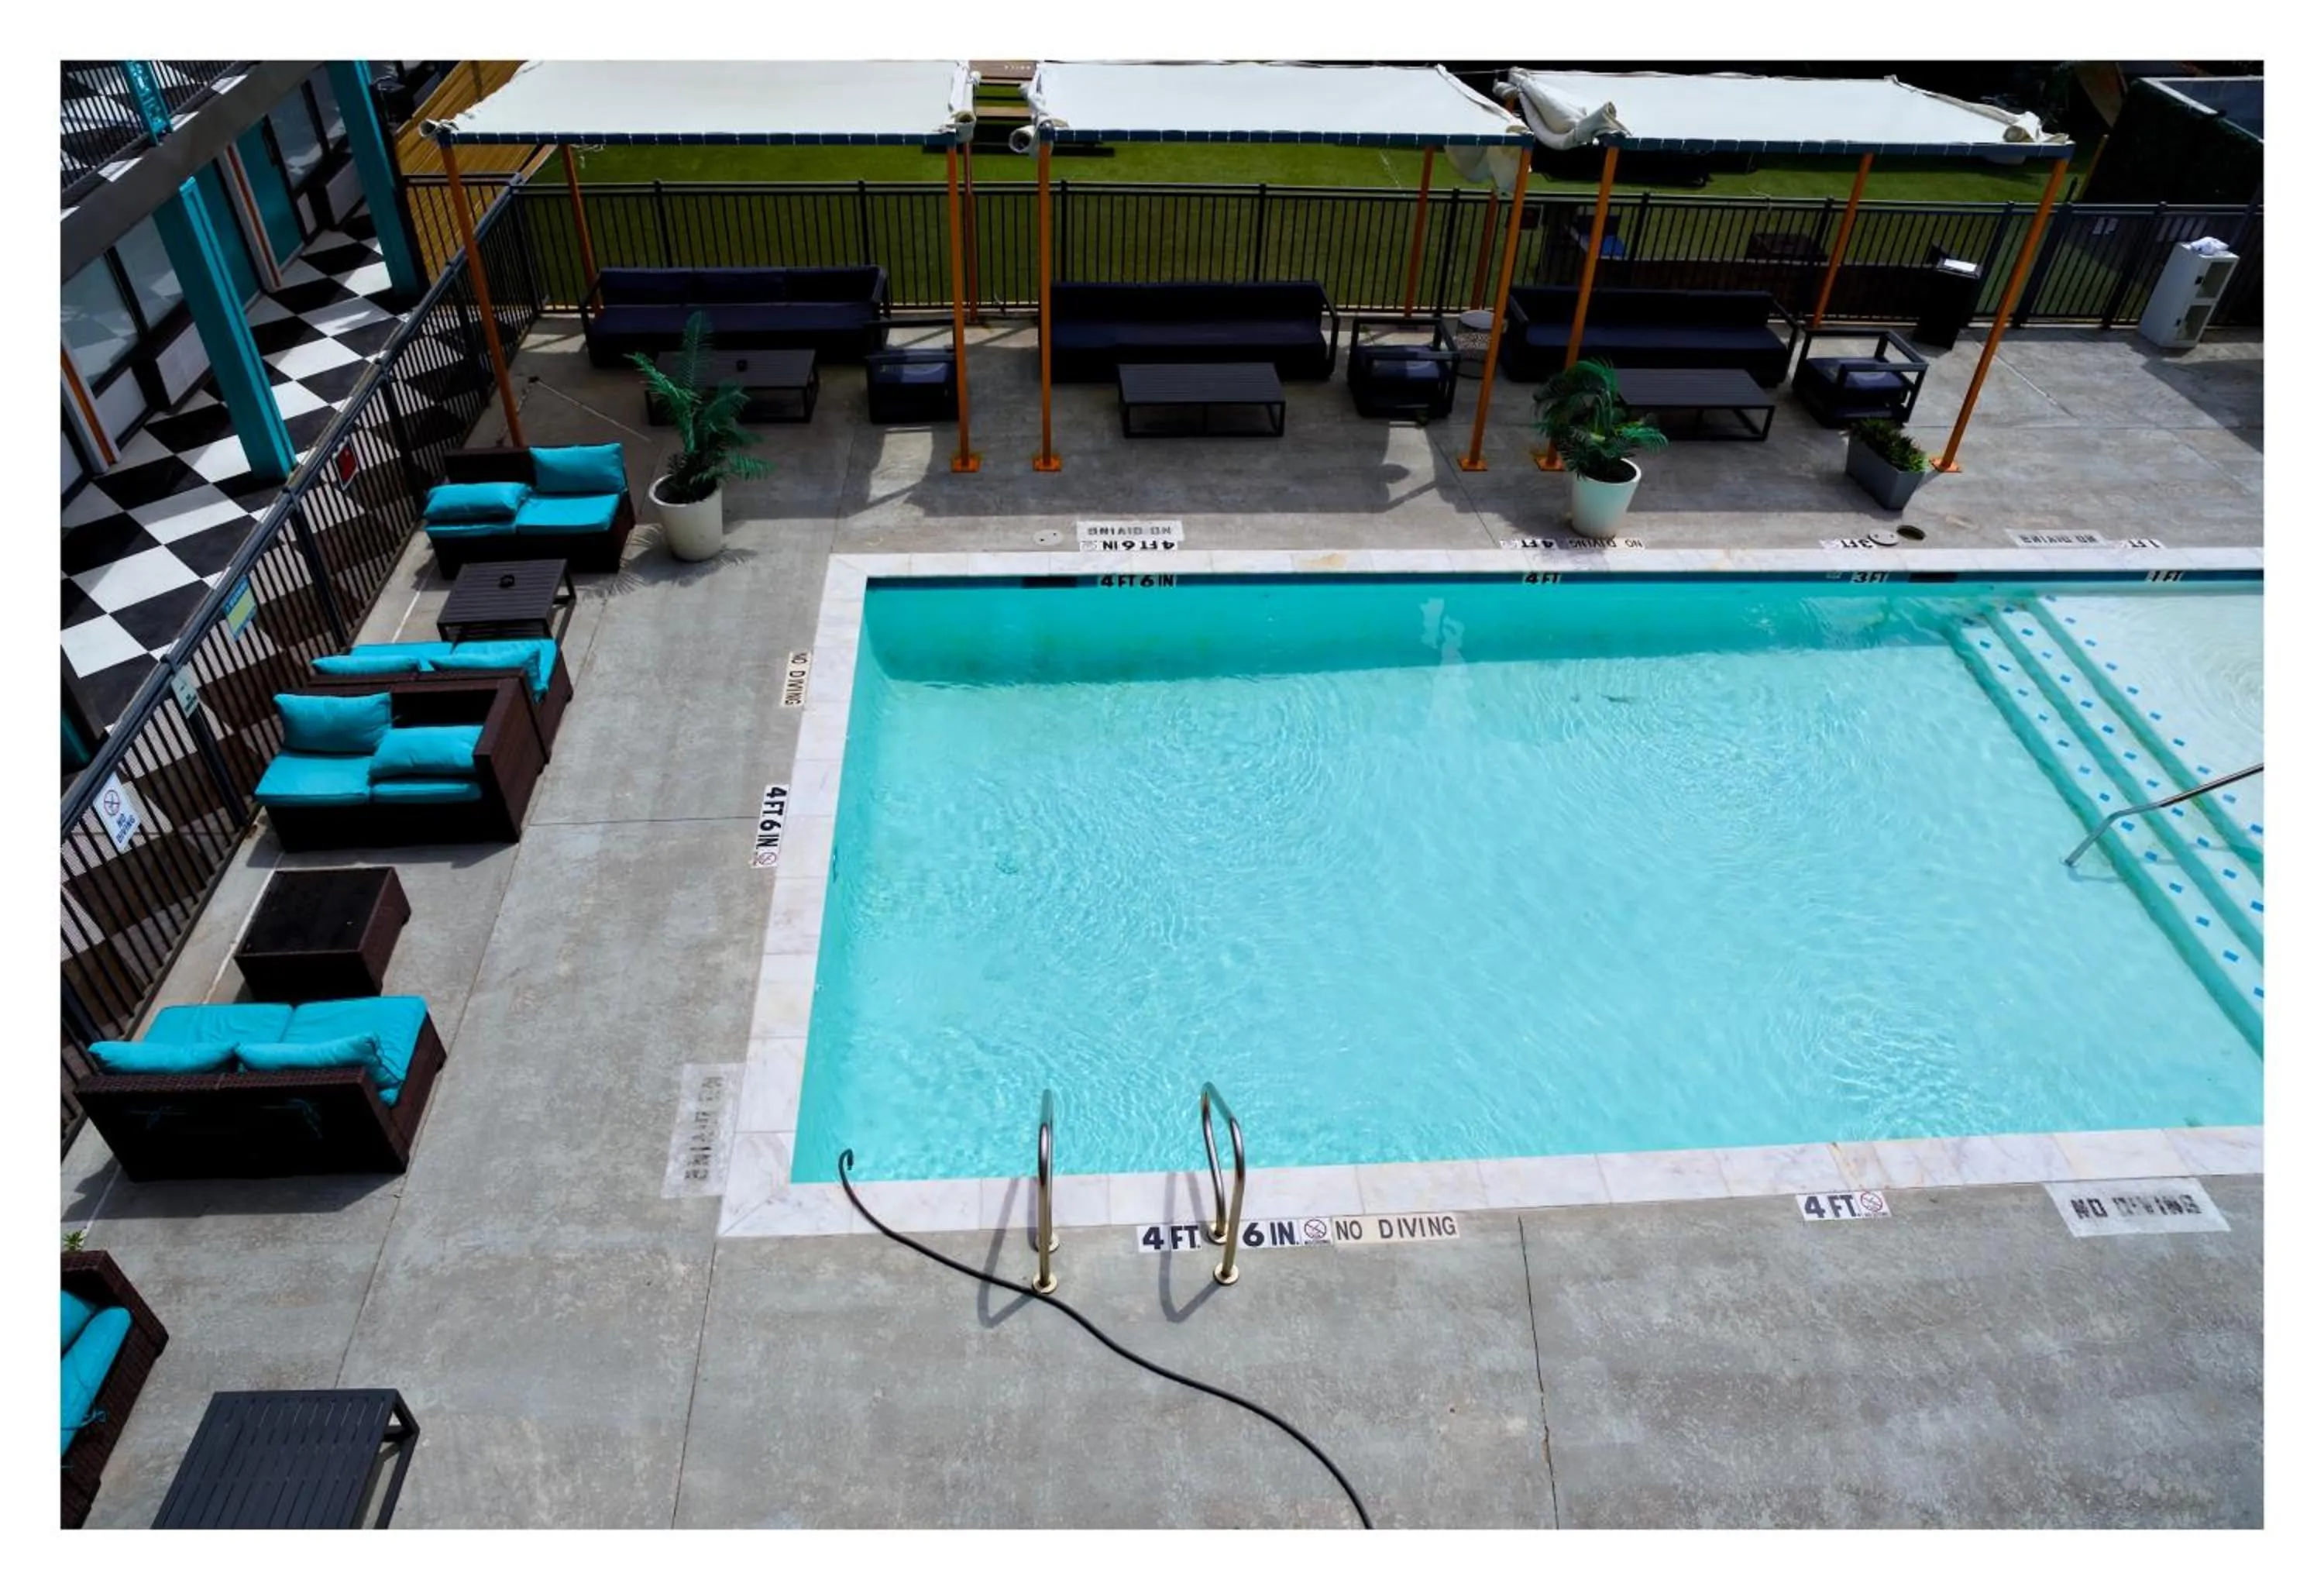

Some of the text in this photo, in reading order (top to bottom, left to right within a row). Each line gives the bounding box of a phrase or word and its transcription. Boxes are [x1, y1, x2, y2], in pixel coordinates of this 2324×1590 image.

[1150, 526, 1172, 535] NO
[1122, 540, 1136, 550] 6
[1162, 540, 1174, 549] 4
[1541, 540, 1553, 549] 4
[1624, 539, 1643, 548] NO
[1101, 573, 1174, 587] 4 FT 6 IN
[1525, 572, 1560, 583] 4 FT
[1854, 571, 1867, 583] 3
[785, 671, 806, 705] DIVING
[765, 786, 787, 798] 4
[760, 820, 781, 831] 6
[1804, 1196, 1825, 1218] 4
[2071, 1198, 2108, 1219] NO
[1336, 1216, 1456, 1240] NO DIVING
[1143, 1227, 1163, 1250] 4
[1243, 1222, 1265, 1247] 6
